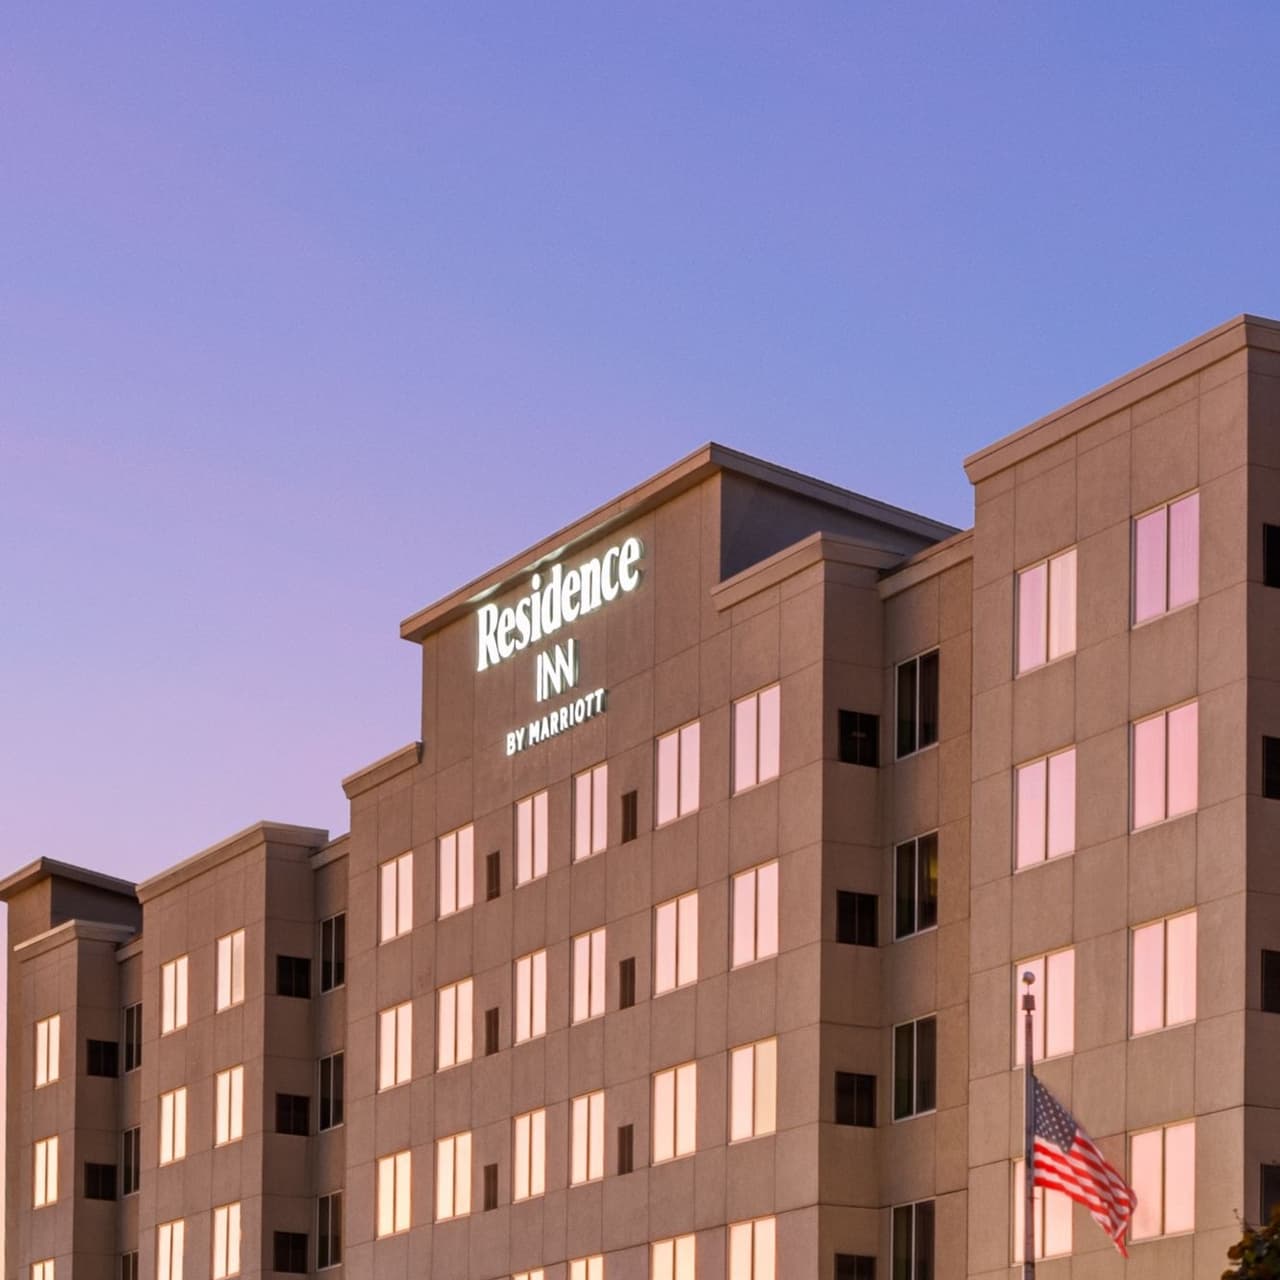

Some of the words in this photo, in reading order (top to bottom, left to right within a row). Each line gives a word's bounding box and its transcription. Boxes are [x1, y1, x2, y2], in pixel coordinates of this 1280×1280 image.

[476, 536, 641, 672] Residence
[536, 638, 575, 702] INN
[506, 727, 526, 756] BY
[528, 687, 605, 746] MARRIOTT
